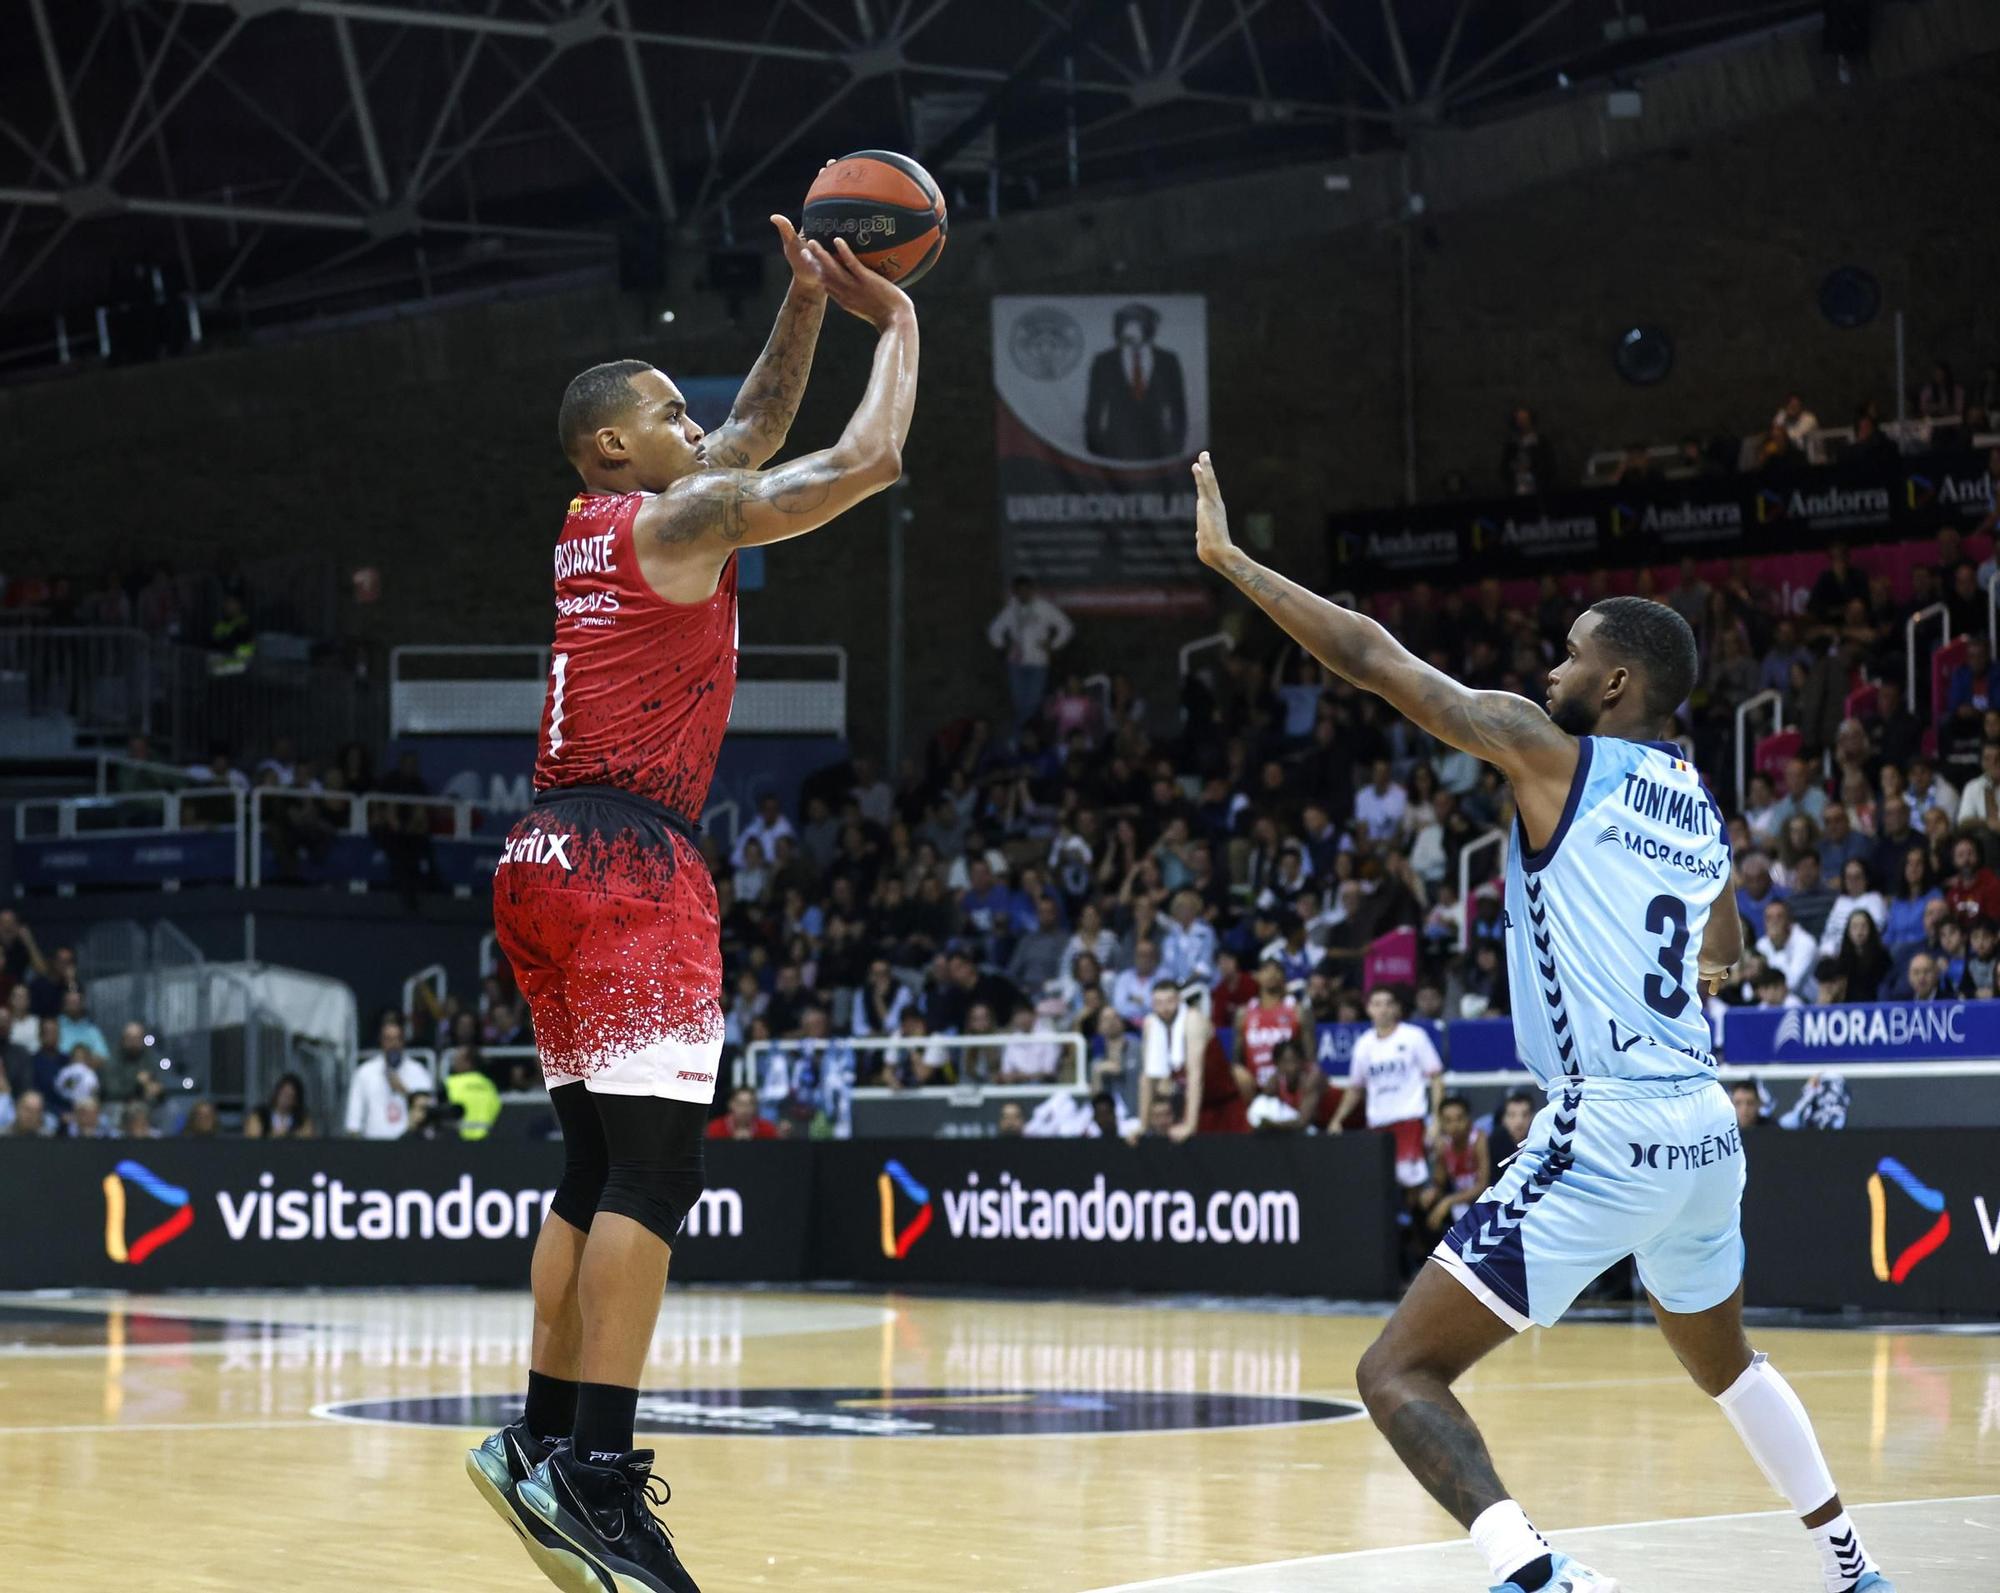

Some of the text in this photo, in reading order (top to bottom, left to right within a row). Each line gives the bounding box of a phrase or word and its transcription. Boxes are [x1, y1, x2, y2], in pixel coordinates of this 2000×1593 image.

[1641, 503, 1742, 531] Andorra
[1787, 487, 1889, 519] Andorra
[1367, 528, 1458, 552] Andorra
[1503, 515, 1597, 544] Andorra
[1624, 773, 1668, 821] TONI
[1644, 894, 1690, 1019] 3
[1804, 1005, 1966, 1048] MORABANC
[943, 1172, 1301, 1244] visitandorra.com
